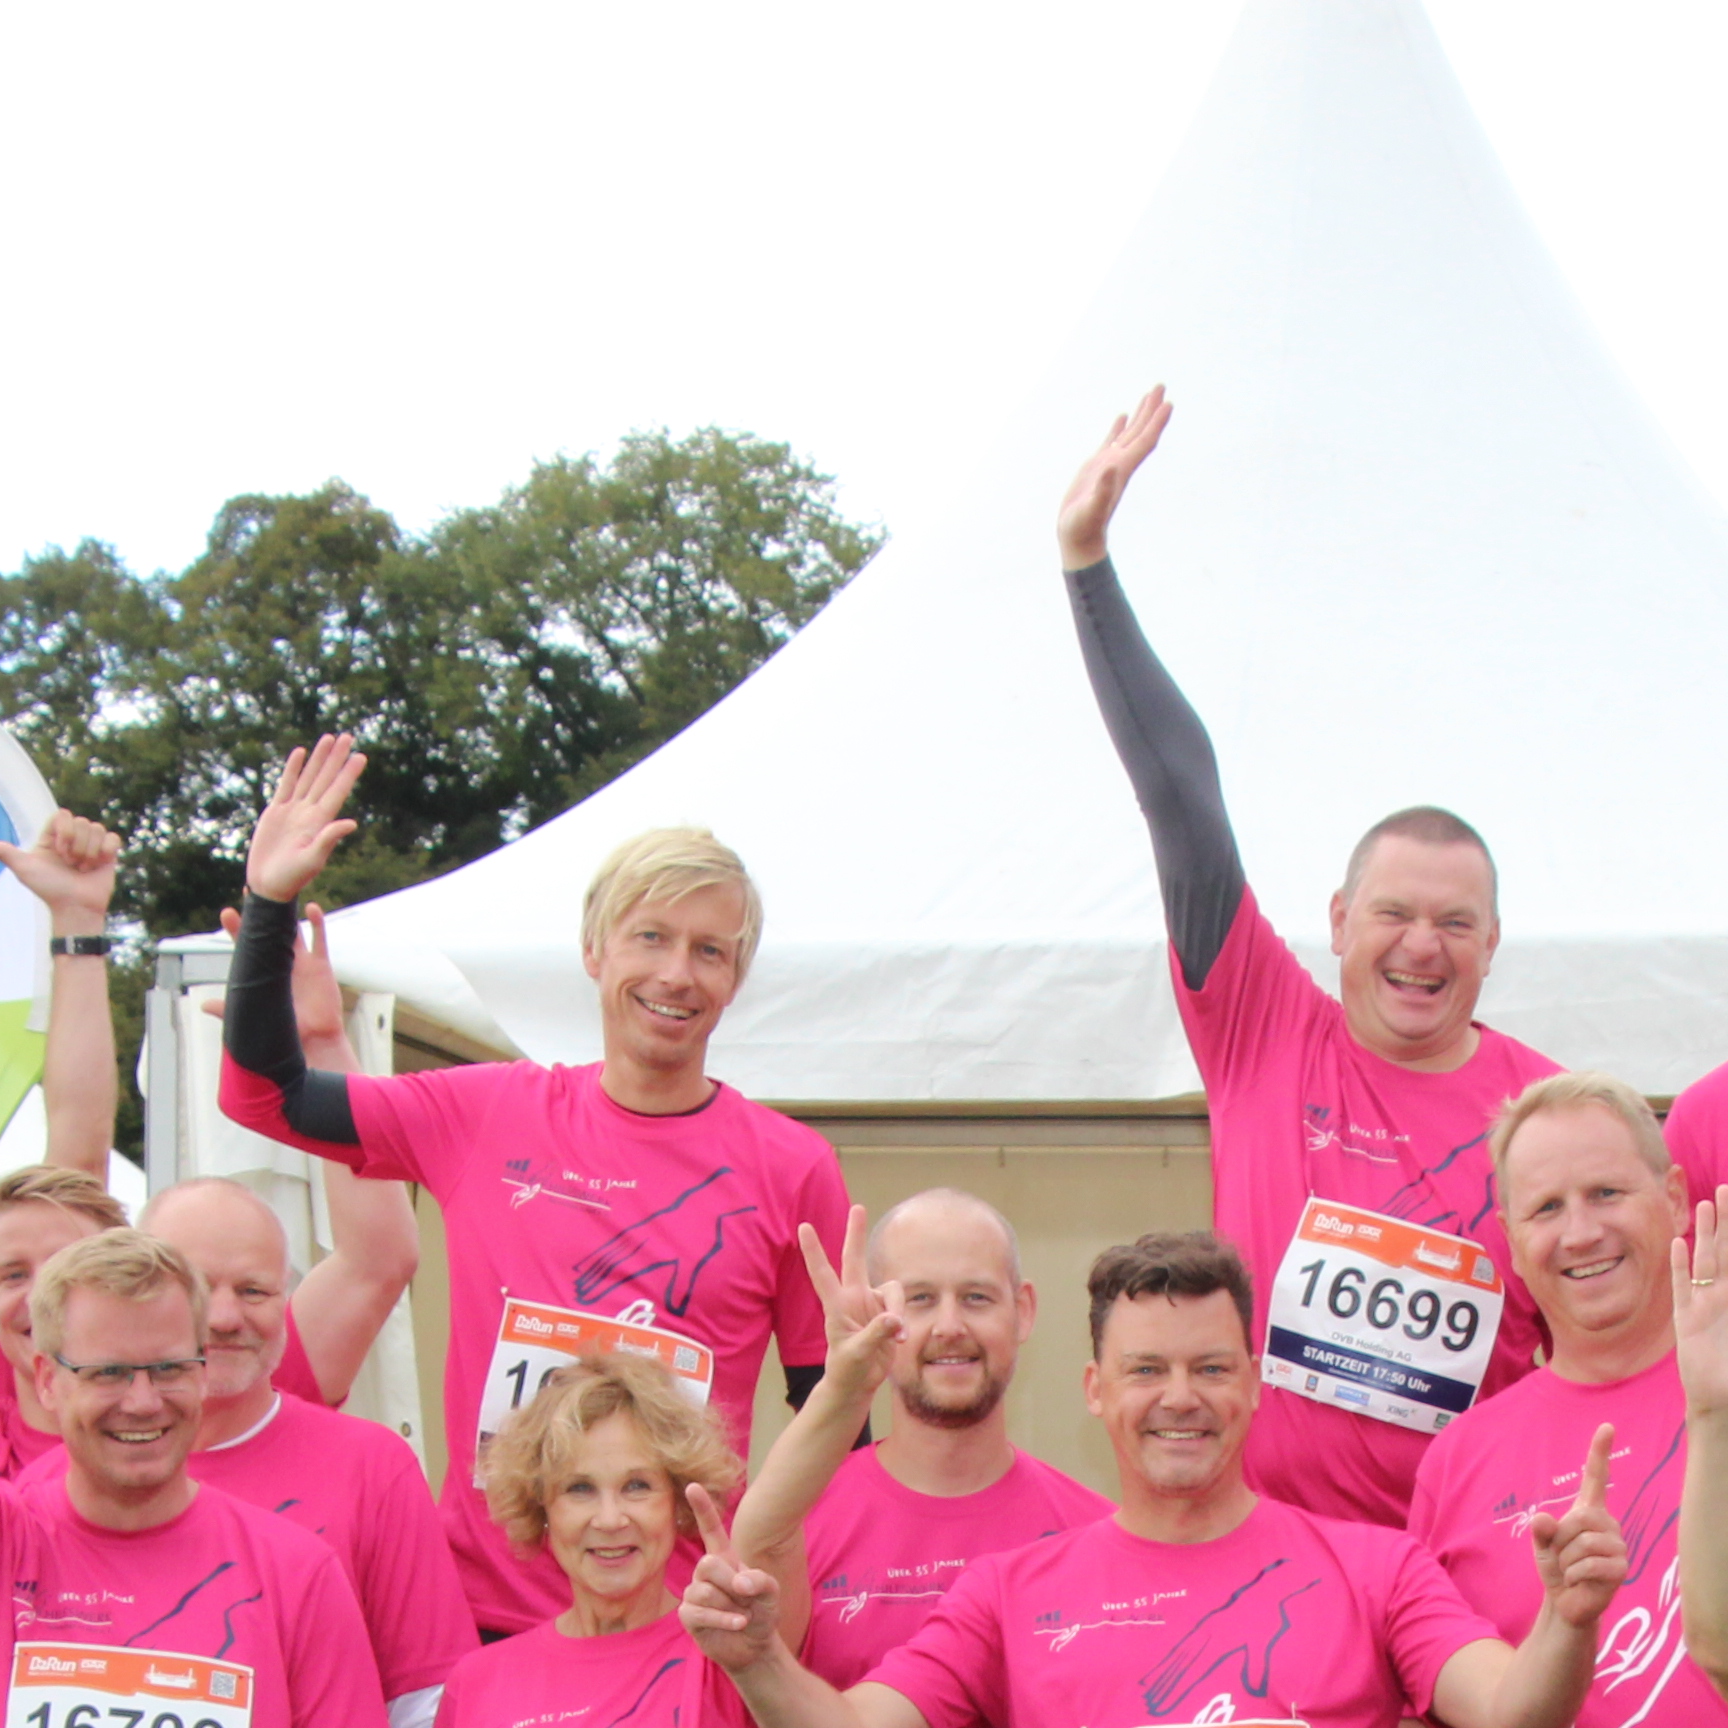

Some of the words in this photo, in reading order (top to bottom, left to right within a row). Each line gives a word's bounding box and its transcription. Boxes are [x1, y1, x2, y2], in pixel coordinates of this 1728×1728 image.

[1299, 1259, 1479, 1353] 16699
[1303, 1346, 1370, 1375] STARTZEIT
[1373, 1367, 1406, 1386] 17:50
[1408, 1376, 1431, 1393] Uhr
[1331, 1332, 1354, 1346] OVB
[1356, 1338, 1393, 1358] Holding
[1396, 1351, 1412, 1362] AG
